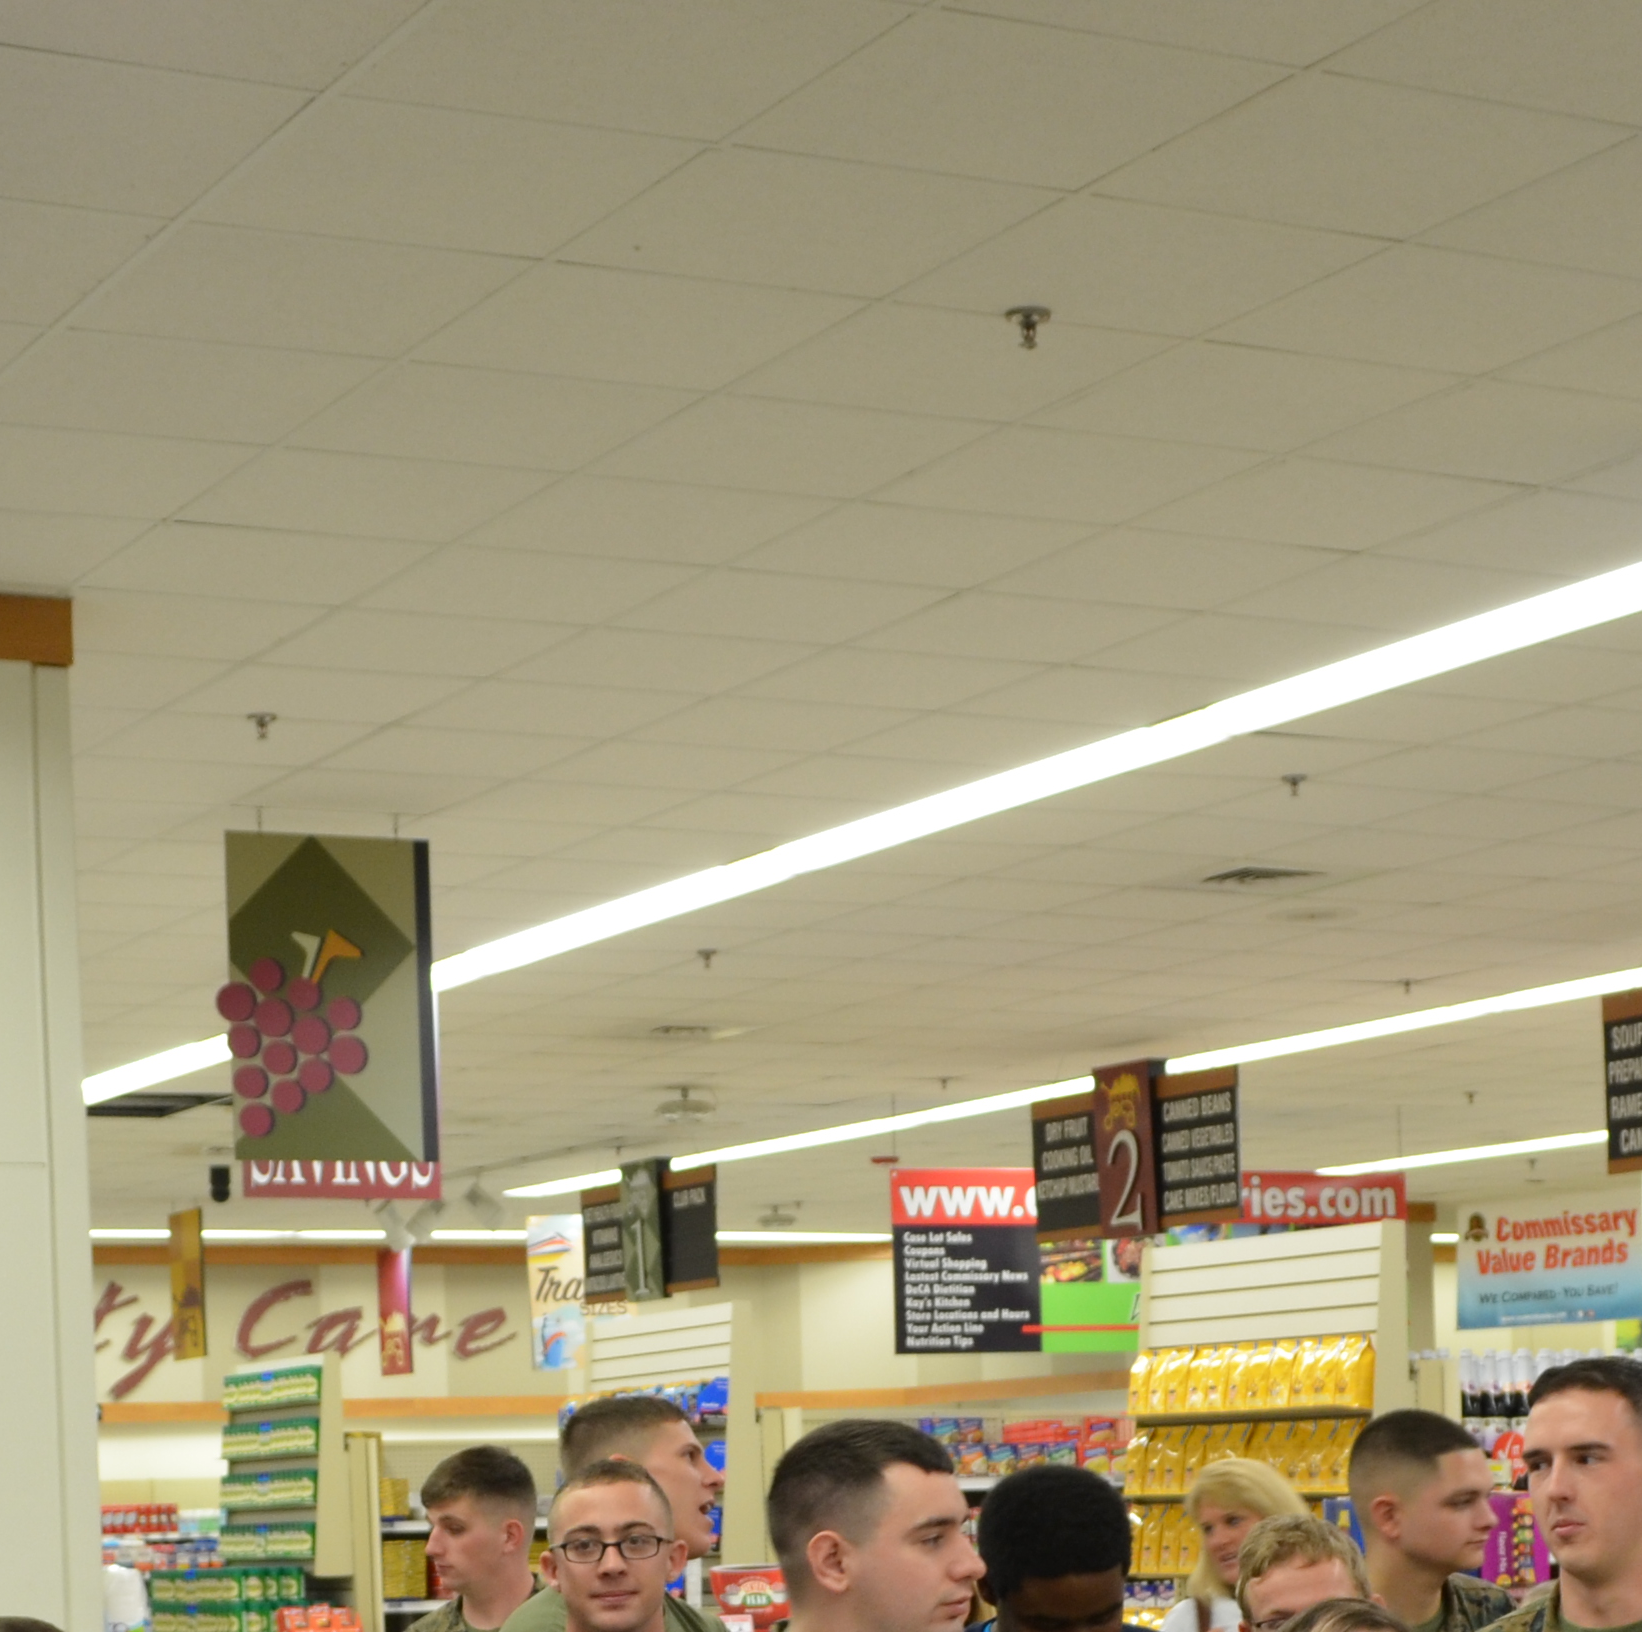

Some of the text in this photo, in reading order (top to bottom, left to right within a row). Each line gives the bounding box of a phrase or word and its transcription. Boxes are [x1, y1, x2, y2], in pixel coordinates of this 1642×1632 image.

[1163, 1097, 1199, 1123] CANNED
[1107, 1129, 1143, 1231] 2
[1496, 1208, 1638, 1243] Commissary
[903, 1232, 972, 1244] Case Lot Sales
[631, 1219, 651, 1295] 1
[903, 1246, 946, 1258] Coupons
[1477, 1238, 1629, 1276] Value Brands
[904, 1258, 988, 1271] Virtual Shopping
[941, 1271, 999, 1284] Commissary
[1001, 1270, 1029, 1281] News
[580, 1300, 627, 1316] SIZES
[934, 1297, 971, 1308] Kitchen
[906, 1308, 1030, 1321] Store Locations and Hours
[906, 1322, 984, 1334] Your Action Line
[906, 1336, 974, 1348] Nutrition Tips
